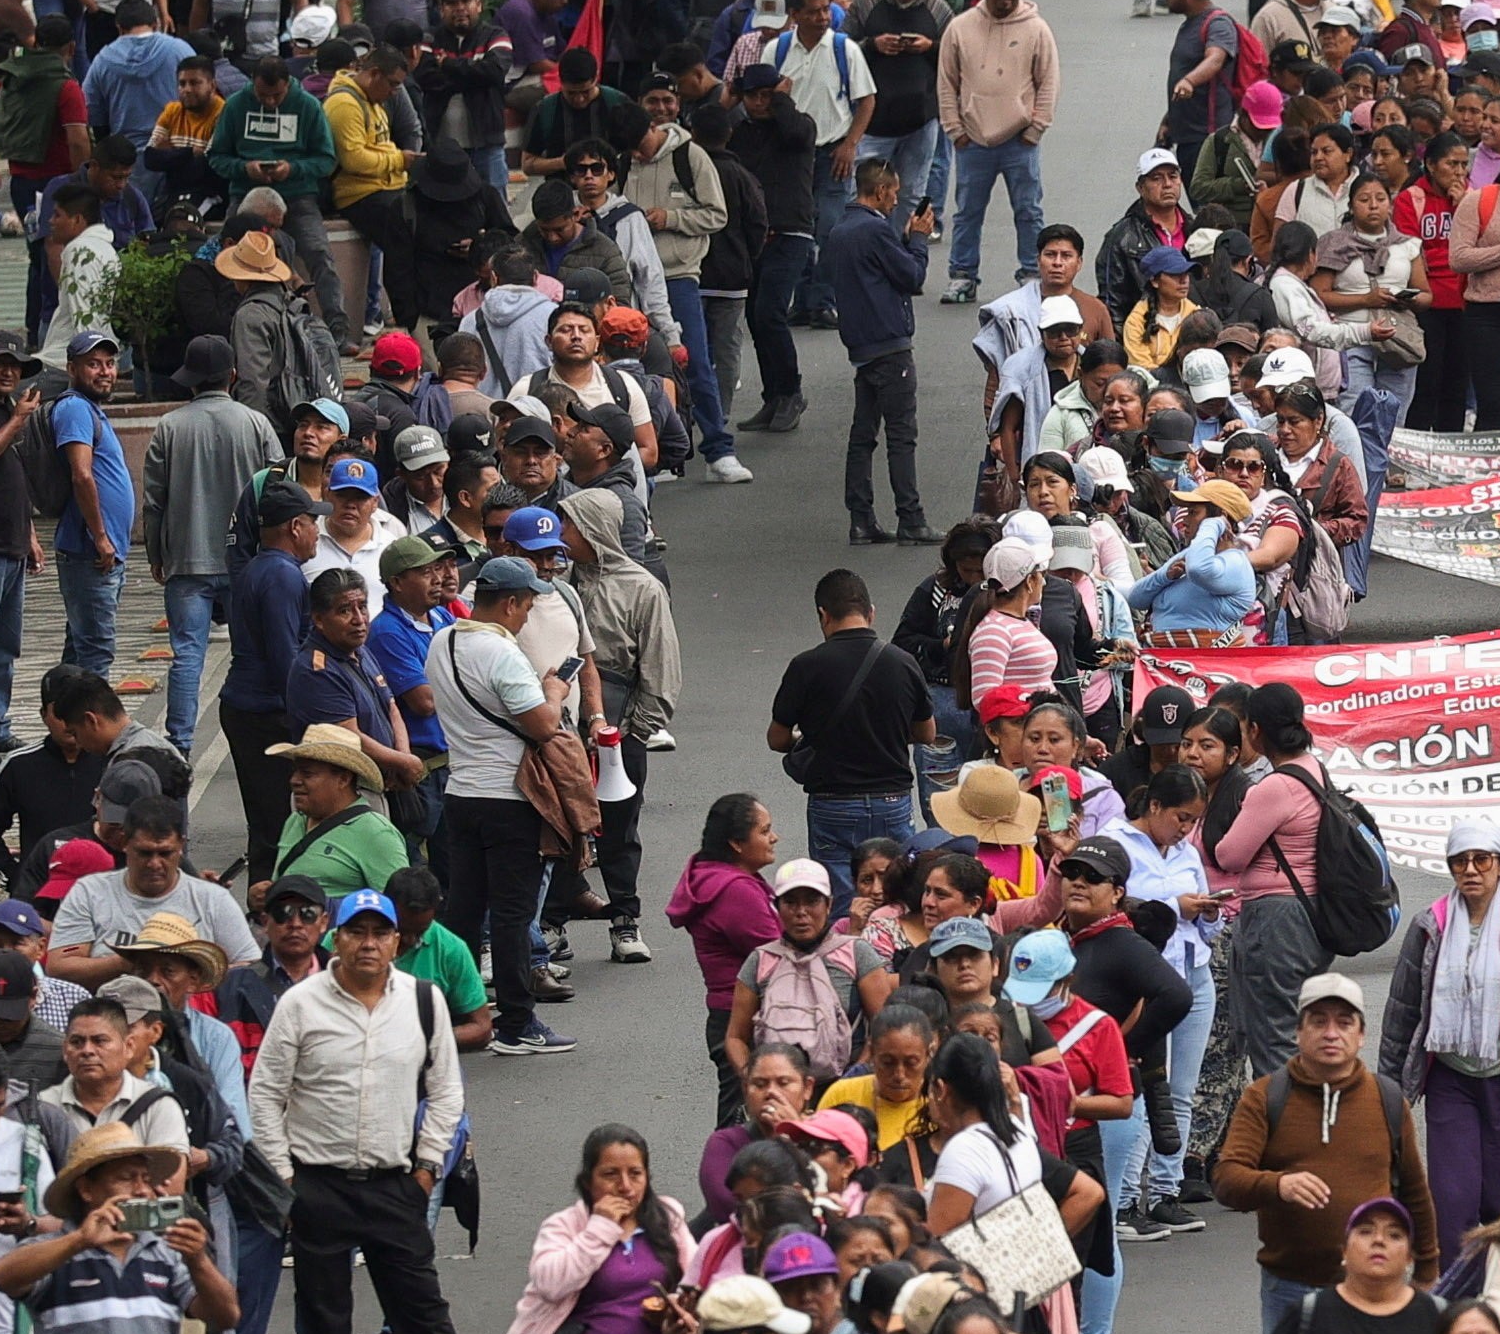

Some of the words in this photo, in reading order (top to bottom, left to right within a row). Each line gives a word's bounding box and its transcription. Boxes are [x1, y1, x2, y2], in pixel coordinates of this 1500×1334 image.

[410, 440, 435, 454] PUMA
[537, 516, 554, 535] D
[1303, 681, 1446, 715] oordinadora
